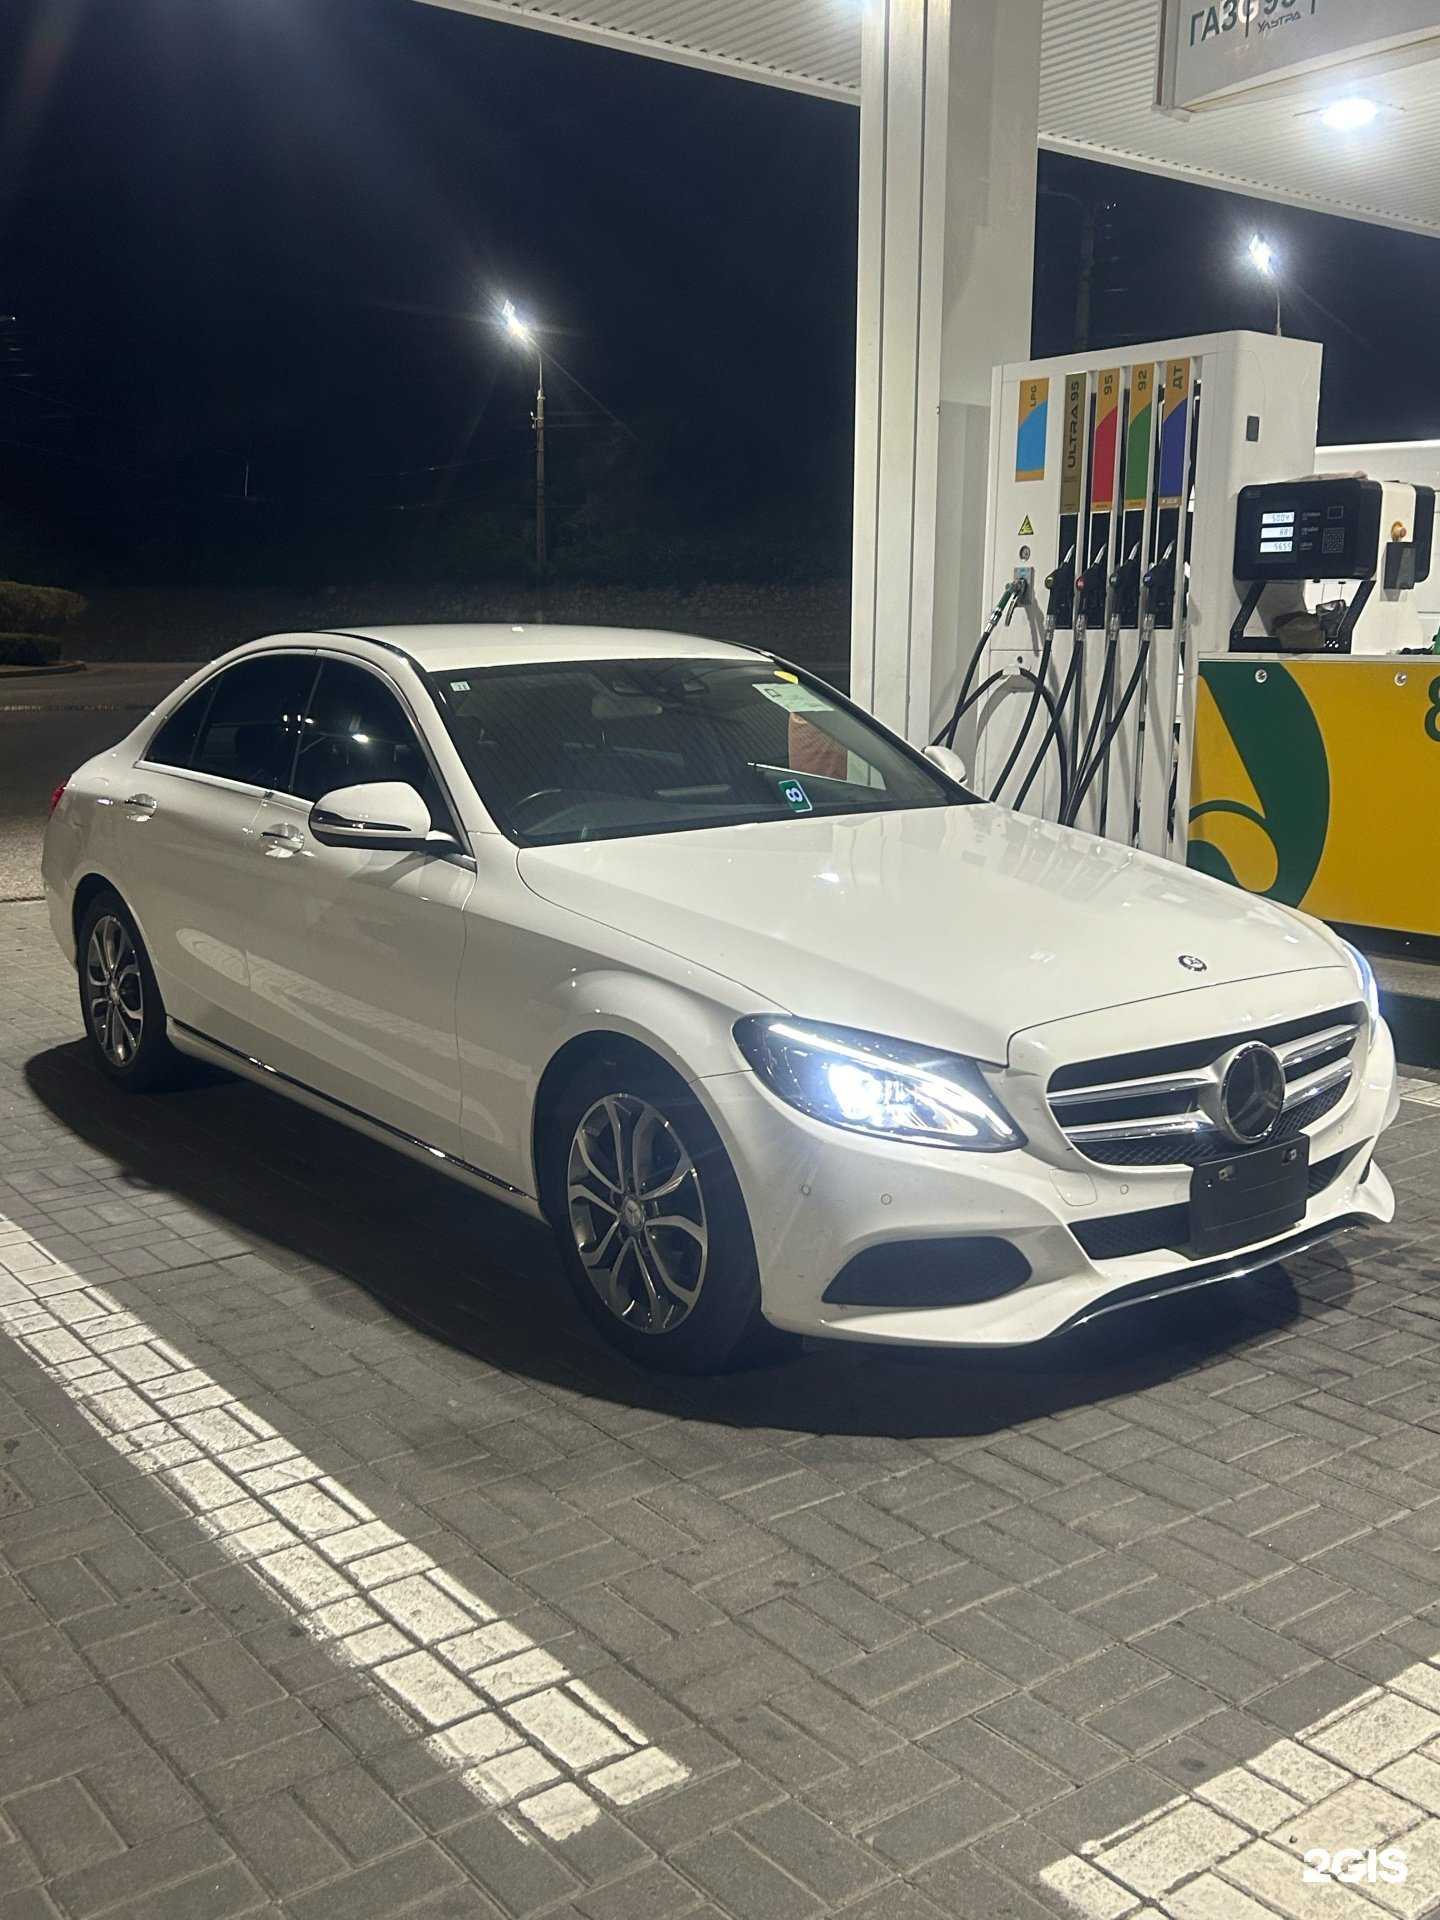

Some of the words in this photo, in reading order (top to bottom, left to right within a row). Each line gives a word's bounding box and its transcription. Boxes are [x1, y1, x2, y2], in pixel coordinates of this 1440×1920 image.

[1190, 0, 1238, 46] ГАЗ
[1070, 381, 1079, 401] 95
[1103, 374, 1113, 395] 95
[1138, 369, 1147, 391] 92
[1067, 404, 1079, 468] ULTRA
